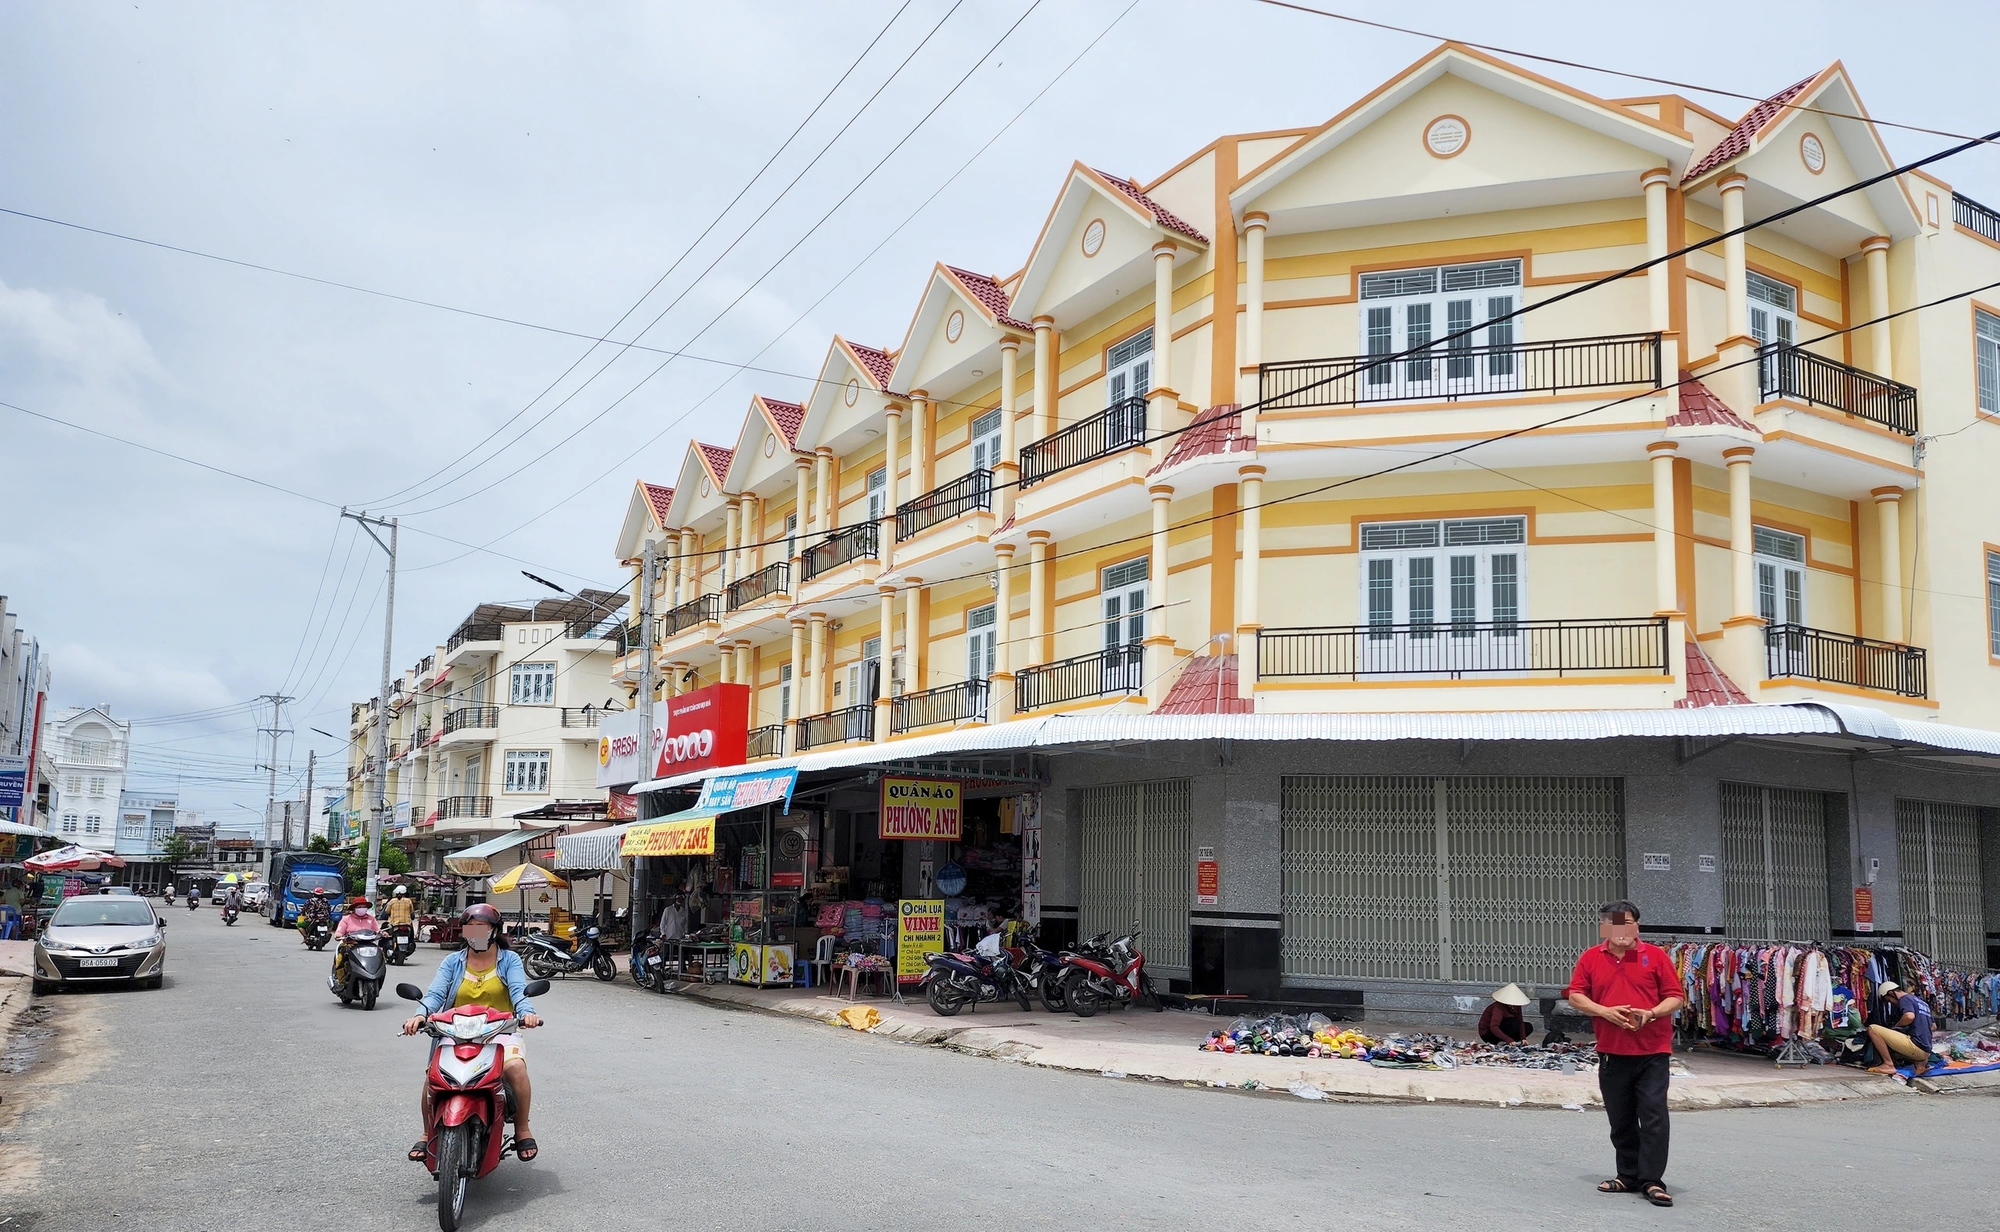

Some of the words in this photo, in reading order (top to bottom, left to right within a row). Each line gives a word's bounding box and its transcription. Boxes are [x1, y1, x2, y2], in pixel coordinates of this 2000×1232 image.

[612, 733, 640, 757] FRESH
[889, 782, 930, 798] QUẦN
[933, 785, 954, 798] ÁO
[886, 800, 932, 834] PHƯƠNG
[933, 807, 957, 835] ANH
[684, 825, 711, 850] ANH
[914, 902, 927, 914] CHẢ
[929, 905, 942, 915] LỤA
[903, 917, 941, 932] VINH
[915, 933, 935, 941] NHÁNH
